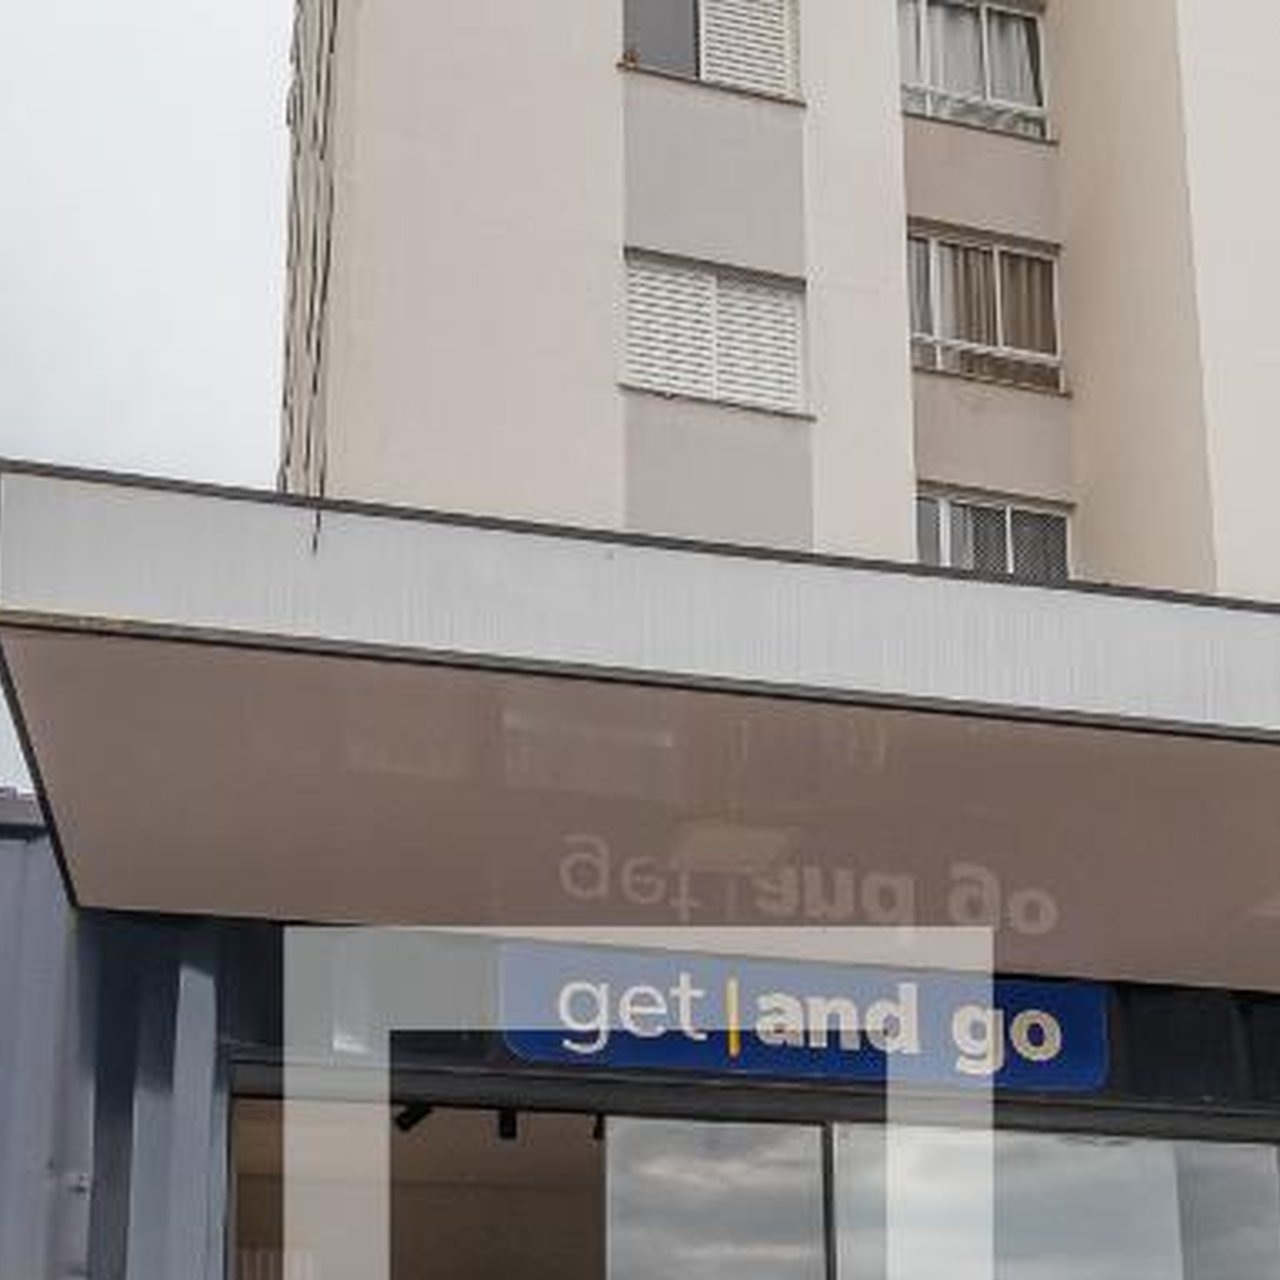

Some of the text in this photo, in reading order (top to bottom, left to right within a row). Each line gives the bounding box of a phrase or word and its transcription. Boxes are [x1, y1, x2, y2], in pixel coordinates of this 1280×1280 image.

[558, 971, 1063, 1076] get and go
